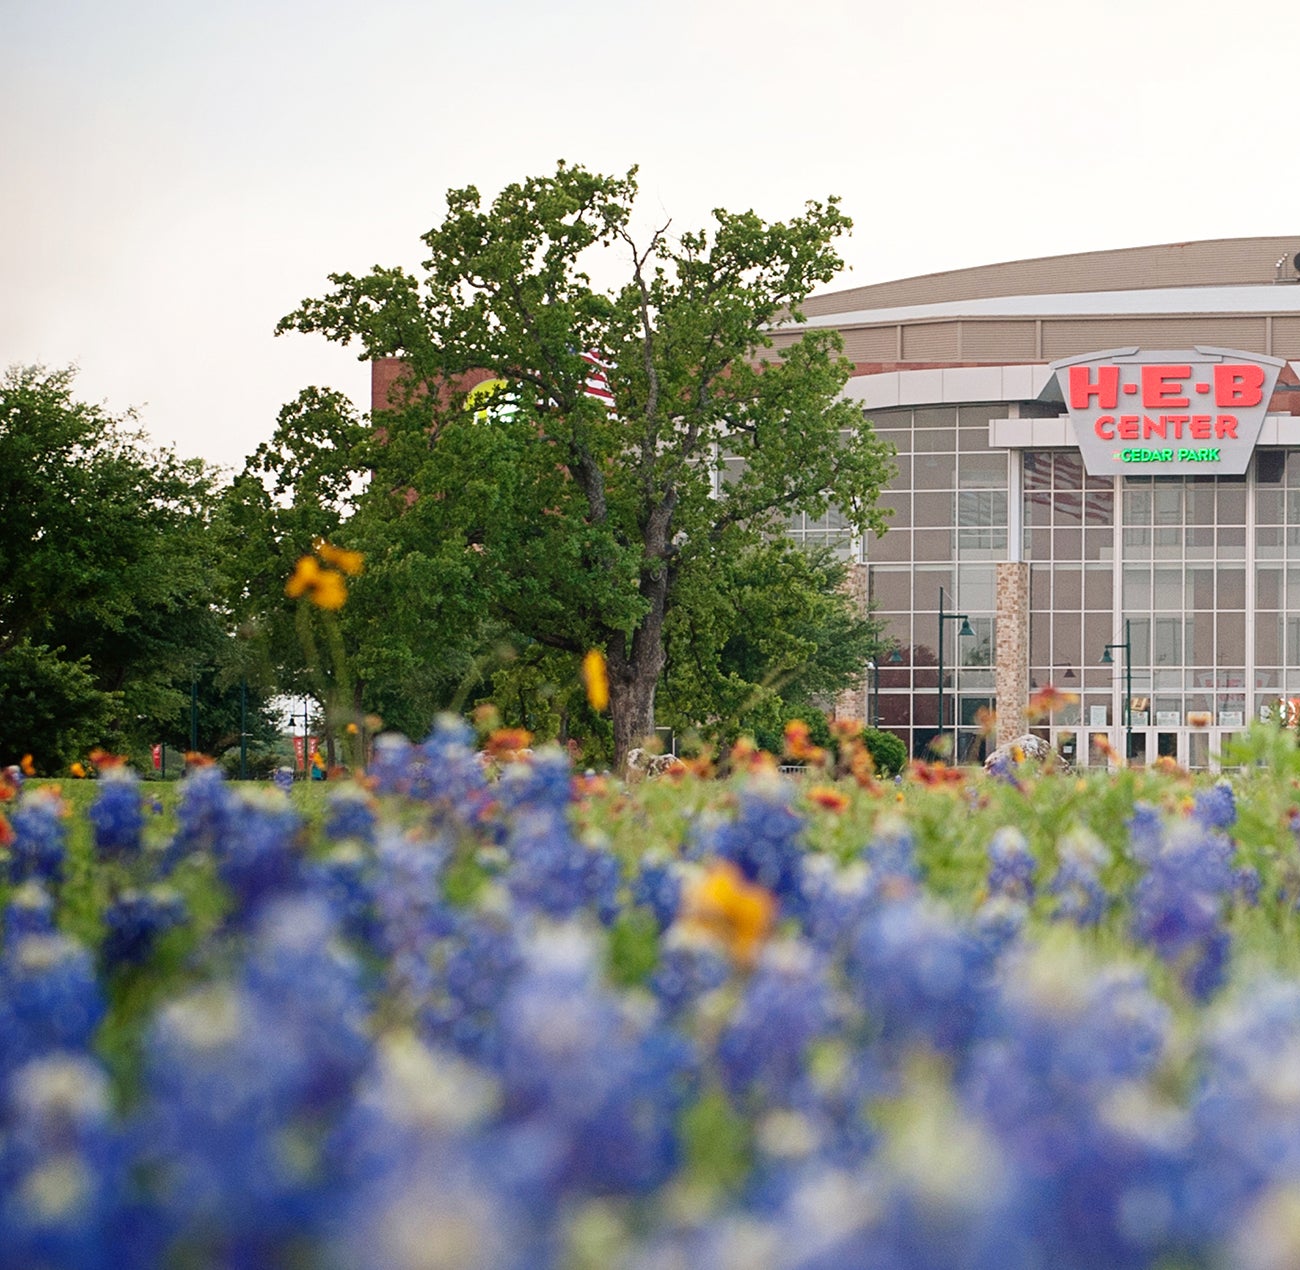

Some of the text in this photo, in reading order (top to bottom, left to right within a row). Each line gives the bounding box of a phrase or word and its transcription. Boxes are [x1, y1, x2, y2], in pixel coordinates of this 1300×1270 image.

[1069, 364, 1265, 409] H-E-B
[1094, 415, 1239, 440] CENTER
[1121, 448, 1174, 462] CEDAR
[1177, 448, 1221, 462] PARK
